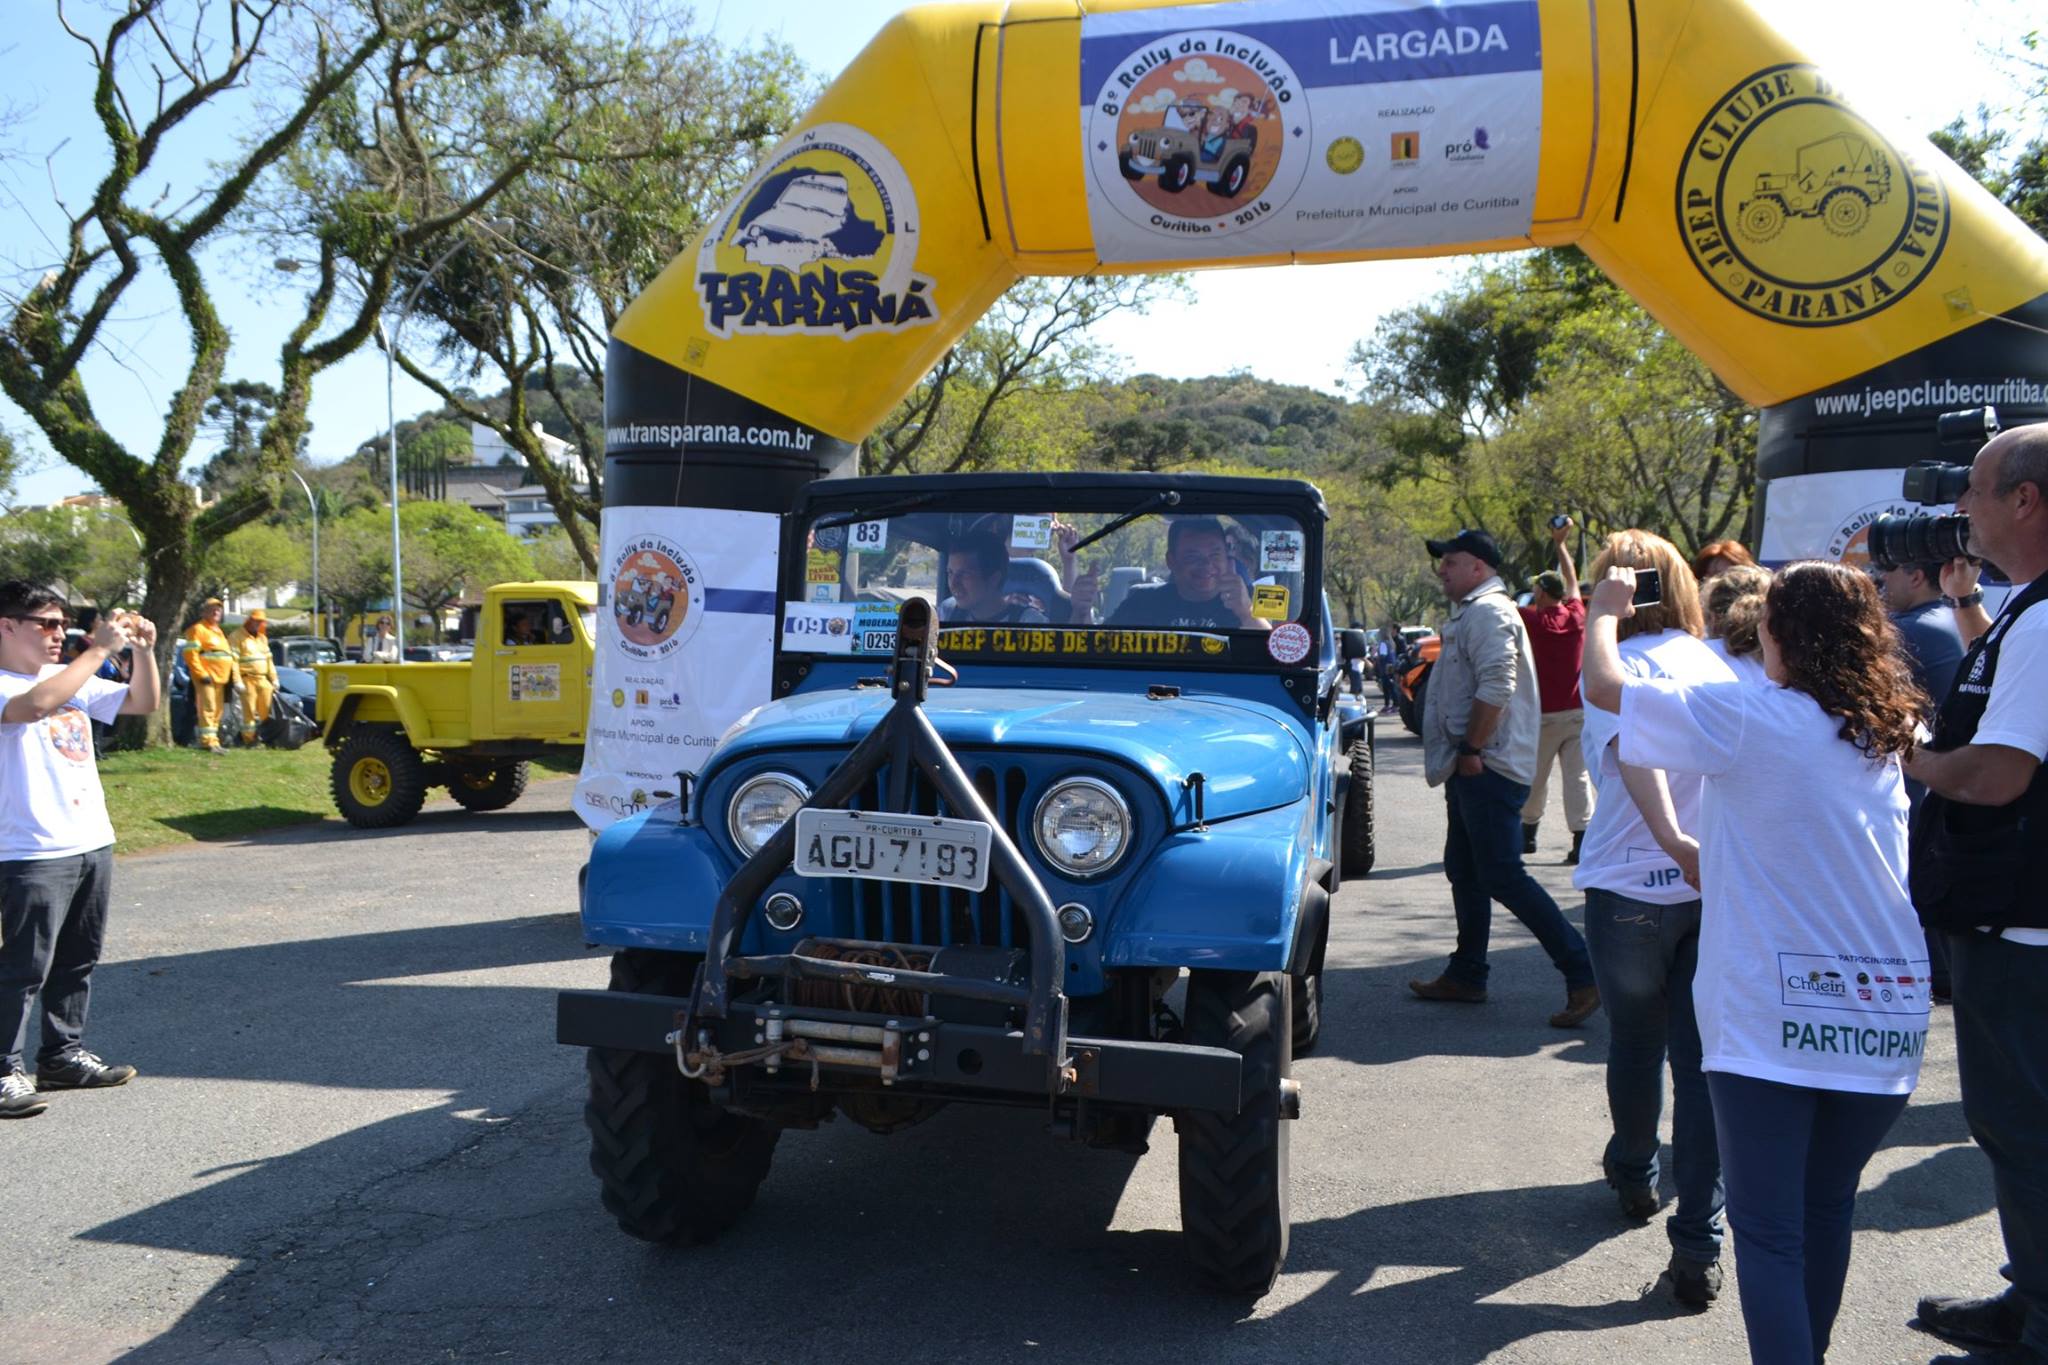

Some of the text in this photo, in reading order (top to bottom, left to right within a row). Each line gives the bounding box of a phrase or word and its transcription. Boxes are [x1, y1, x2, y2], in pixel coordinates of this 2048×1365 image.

[1329, 23, 1509, 65] LARGADA
[1118, 47, 1173, 90] Rally
[1179, 38, 1207, 54] da
[1216, 37, 1292, 104] Inclusão
[1378, 106, 1436, 119] REALIZAÇÃO
[1698, 73, 1795, 162] CLUBE
[1445, 139, 1472, 159] pró
[1393, 186, 1418, 195] APOIO
[1150, 201, 1271, 233] Curitiba 2016
[1296, 196, 1520, 222] Prefeitura Municipal de Curitiba
[1687, 187, 1734, 269] JEEP
[699, 264, 882, 303] TRANS
[1739, 264, 1897, 319] PARANÁ
[709, 279, 933, 332] PARANÁ
[856, 522, 881, 543] 83
[616, 543, 638, 567] Rally
[639, 538, 654, 550] da
[656, 540, 695, 585] Inclusão
[792, 617, 822, 635] 09
[619, 638, 679, 658] Curitiba 2016
[867, 632, 898, 649] 0293
[938, 631, 987, 652] JEEP
[992, 630, 1057, 652] CLUBE
[1062, 631, 1088, 653] DE
[624, 675, 664, 686] REALIZAÇÃO
[630, 718, 655, 728] APOIO
[618, 730, 664, 745] Municipal
[666, 733, 680, 745] de
[1643, 868, 1681, 888] JIP
[1787, 975, 1847, 994] Chueiri
